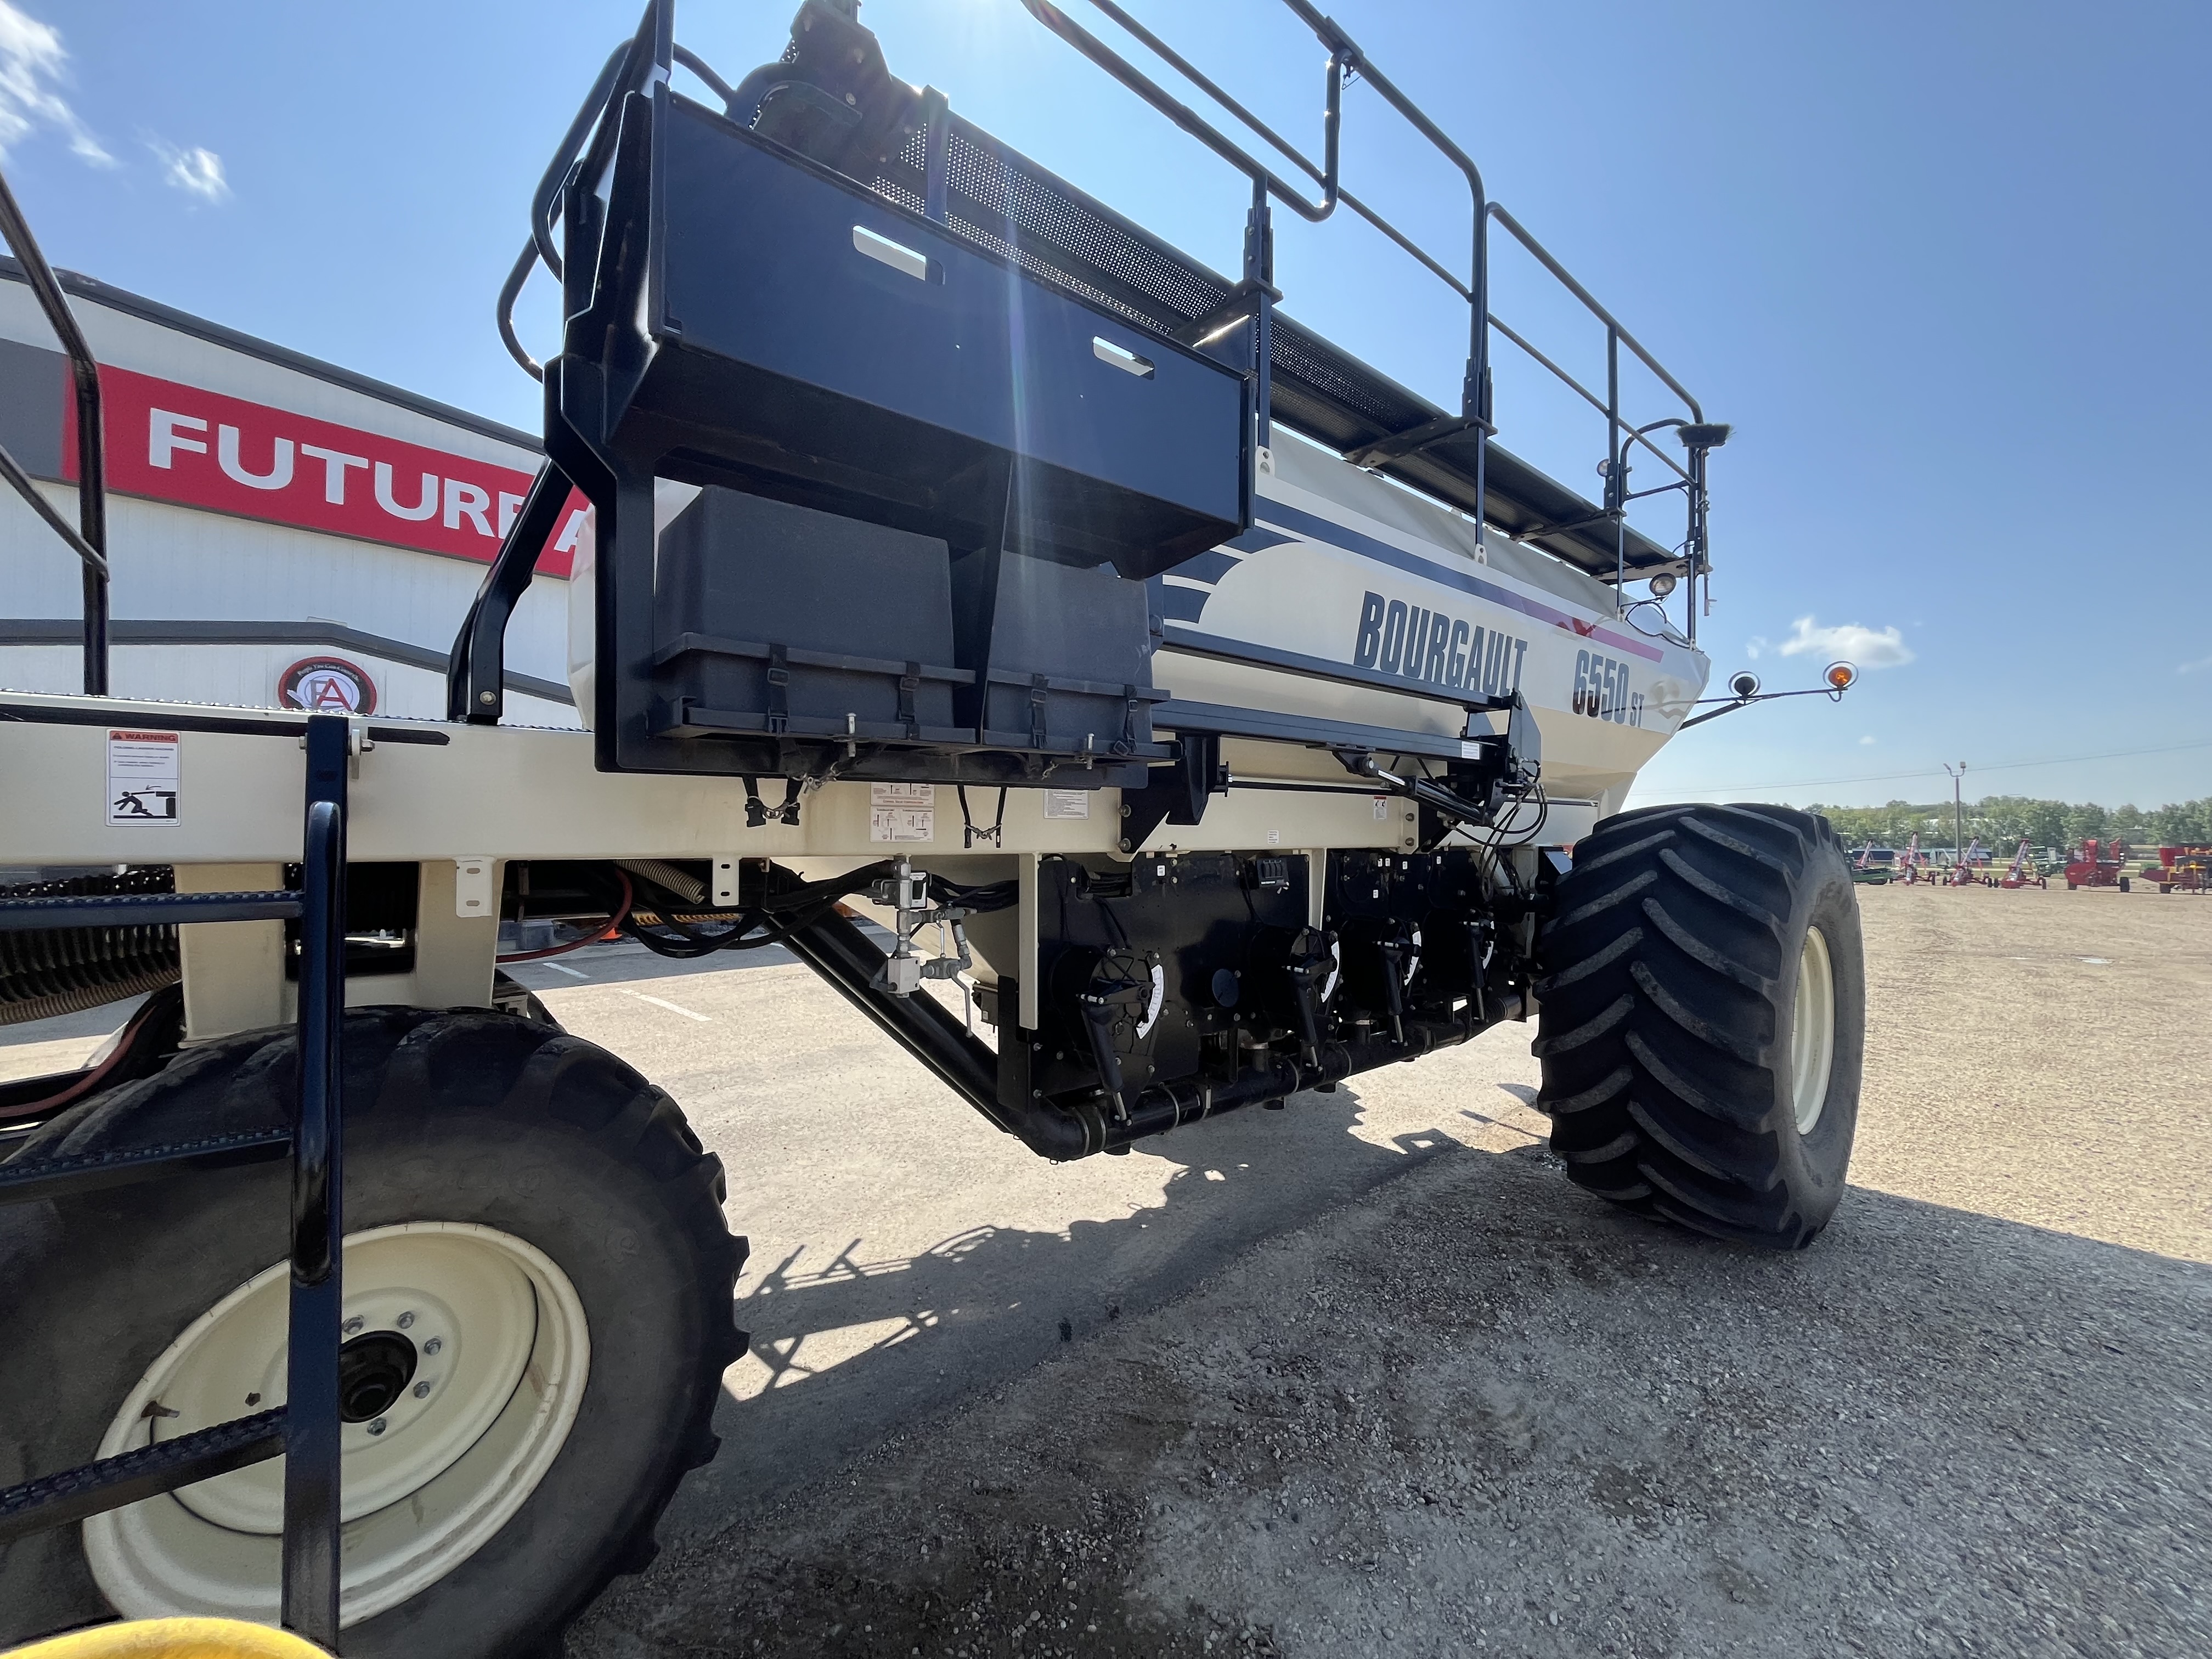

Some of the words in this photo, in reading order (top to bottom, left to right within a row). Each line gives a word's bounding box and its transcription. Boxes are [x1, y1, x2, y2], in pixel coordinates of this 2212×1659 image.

[1353, 590, 1528, 697] BOURGAULT
[1572, 648, 1629, 724] 6550
[1629, 692, 1645, 727] ST
